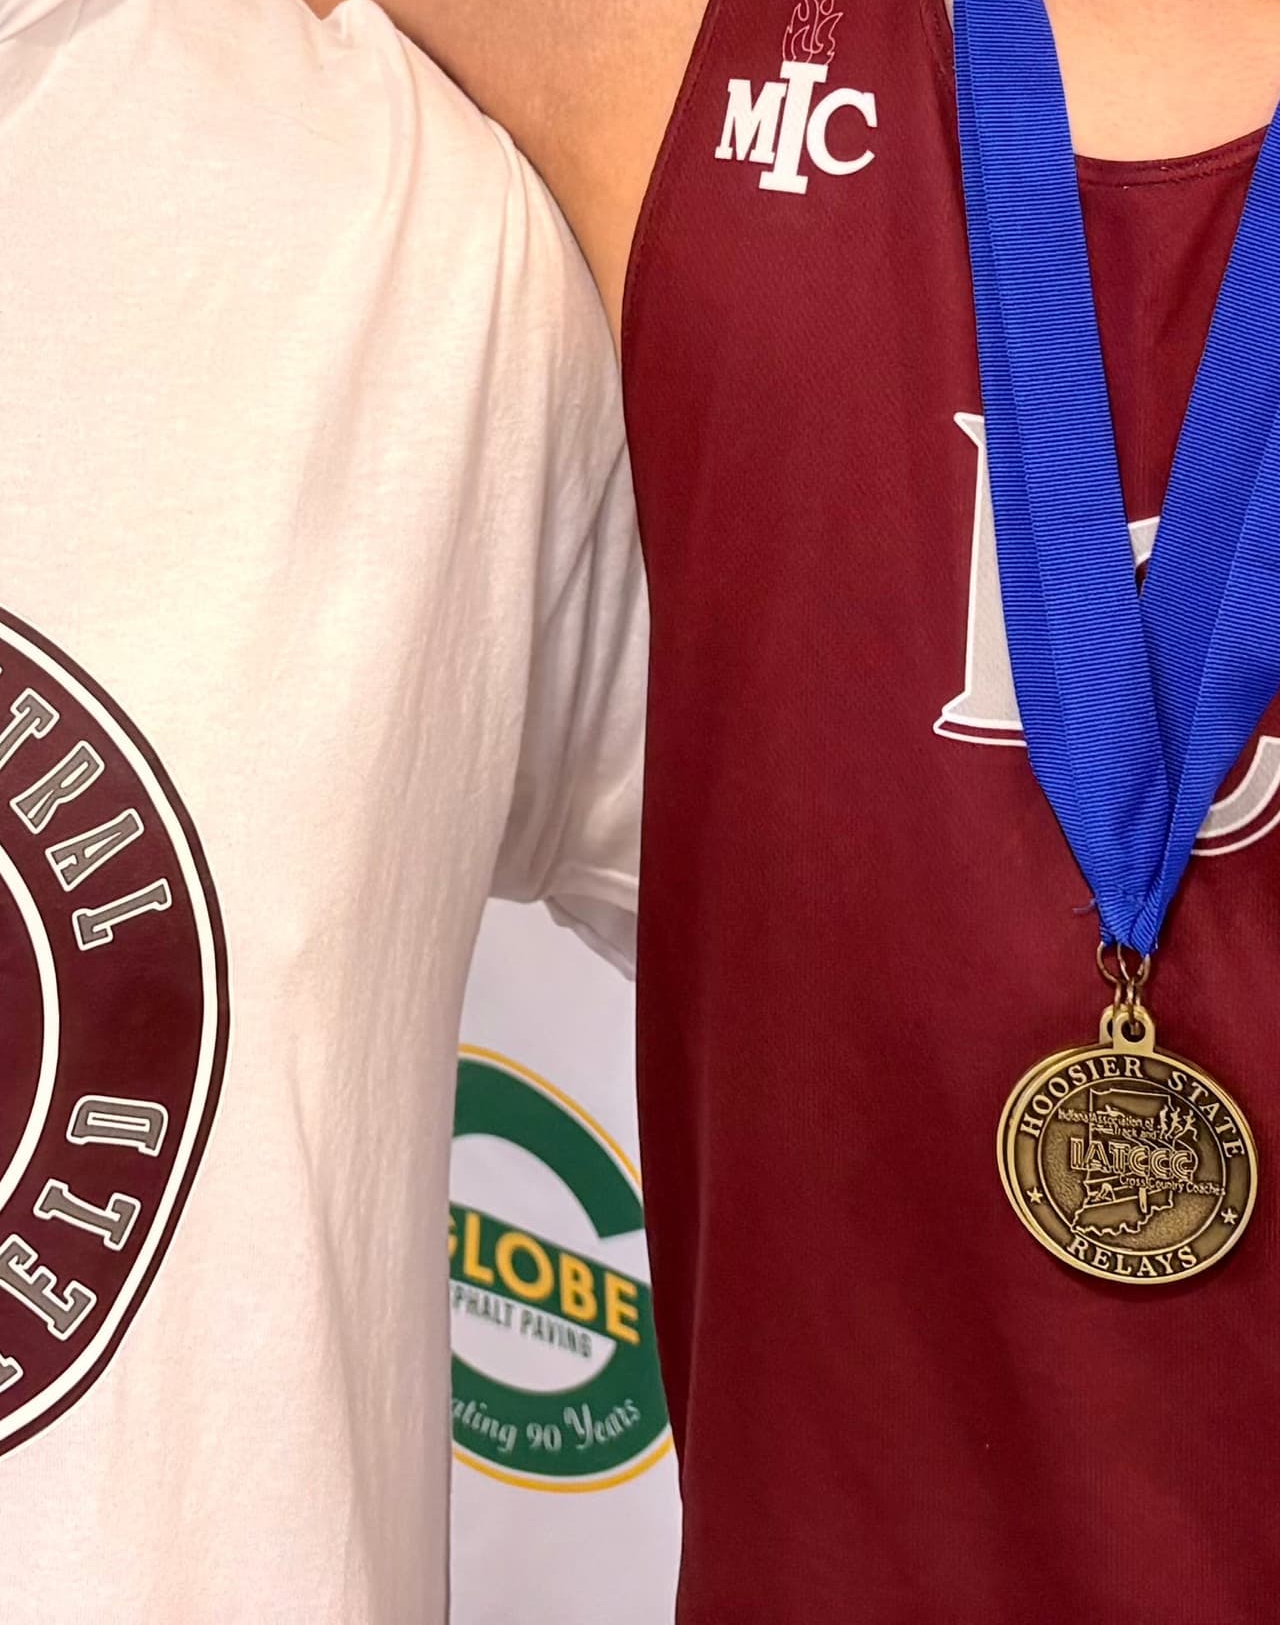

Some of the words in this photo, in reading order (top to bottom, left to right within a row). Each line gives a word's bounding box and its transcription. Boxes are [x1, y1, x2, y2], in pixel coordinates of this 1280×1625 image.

[714, 60, 878, 195] MIC
[1020, 1056, 1144, 1138] HOOSIER
[1168, 1071, 1246, 1159] STATE
[1068, 1234, 1198, 1277] RELAYS
[452, 1285, 515, 1330] PHALT
[520, 1308, 592, 1359] PAVING
[526, 1422, 562, 1452] 90
[563, 1397, 641, 1451] Years
